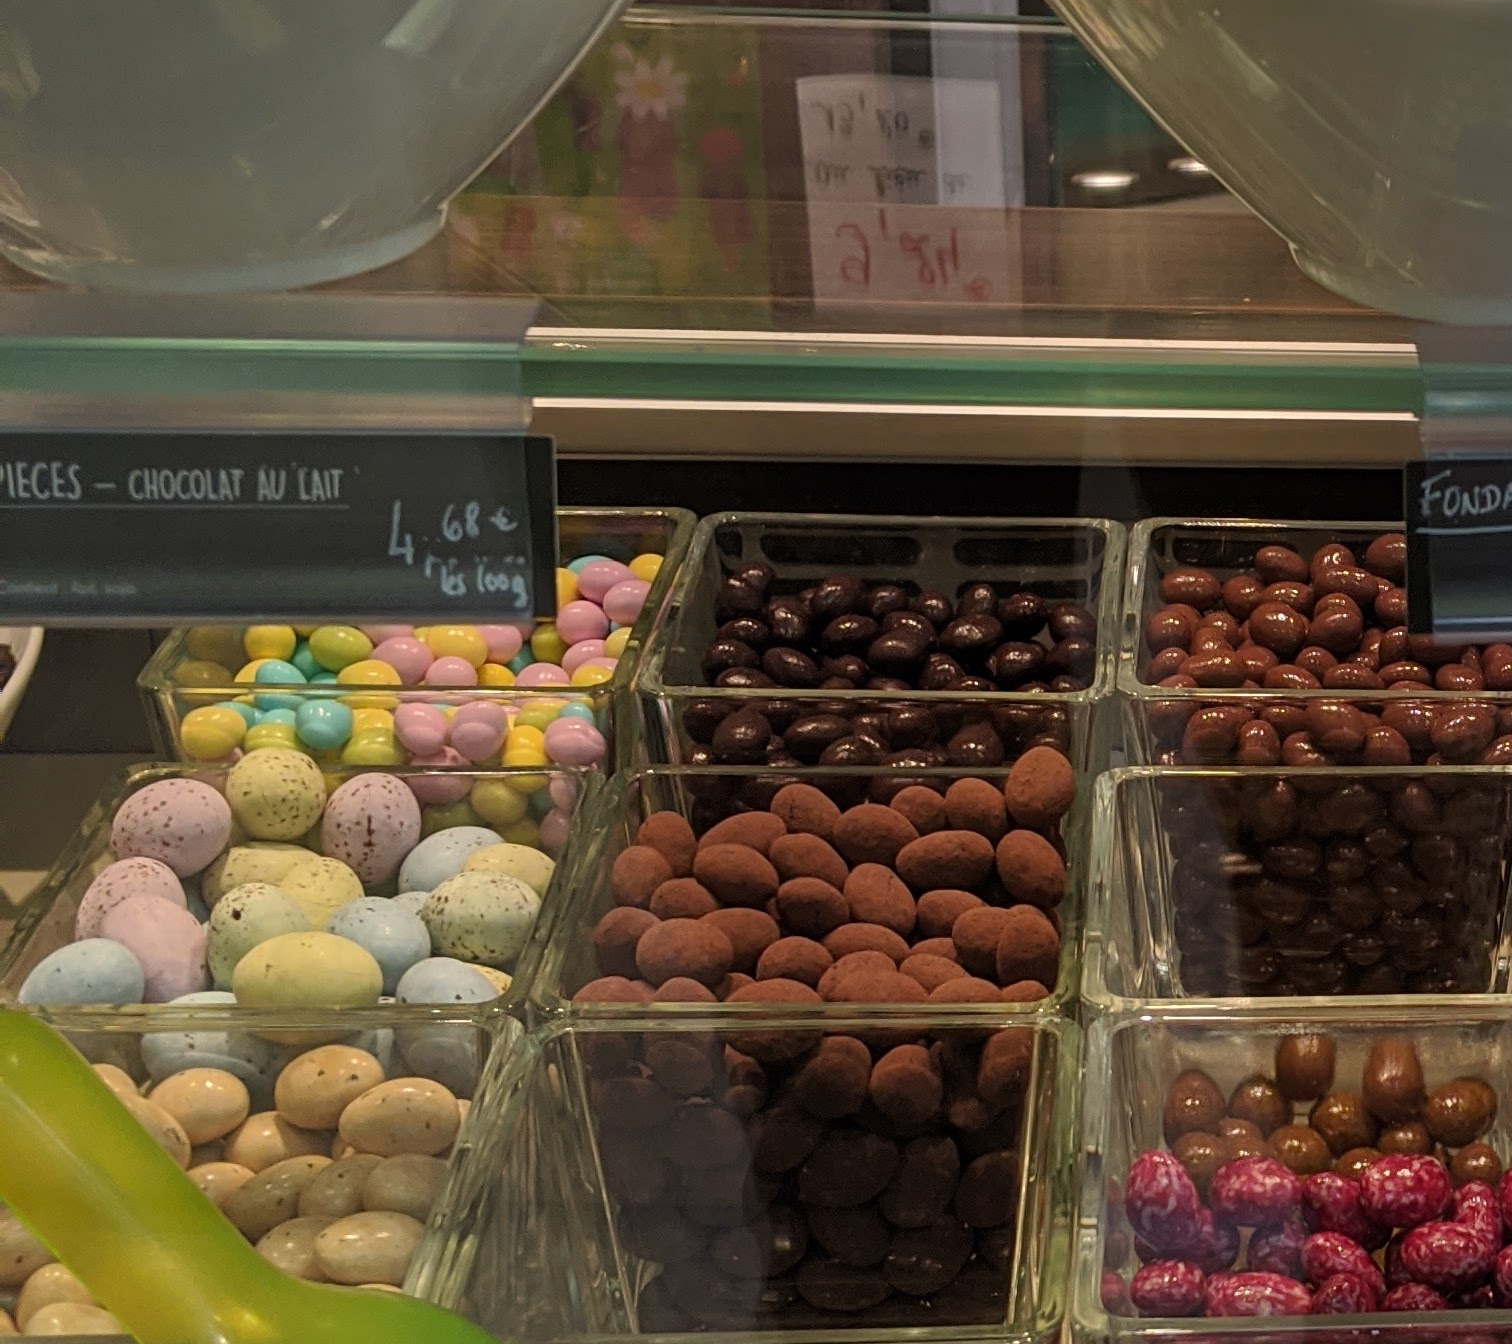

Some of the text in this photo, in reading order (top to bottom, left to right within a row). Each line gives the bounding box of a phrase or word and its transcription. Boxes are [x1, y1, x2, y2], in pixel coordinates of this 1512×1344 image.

[128, 466, 342, 502] CHOCOLAT AU LAIT
